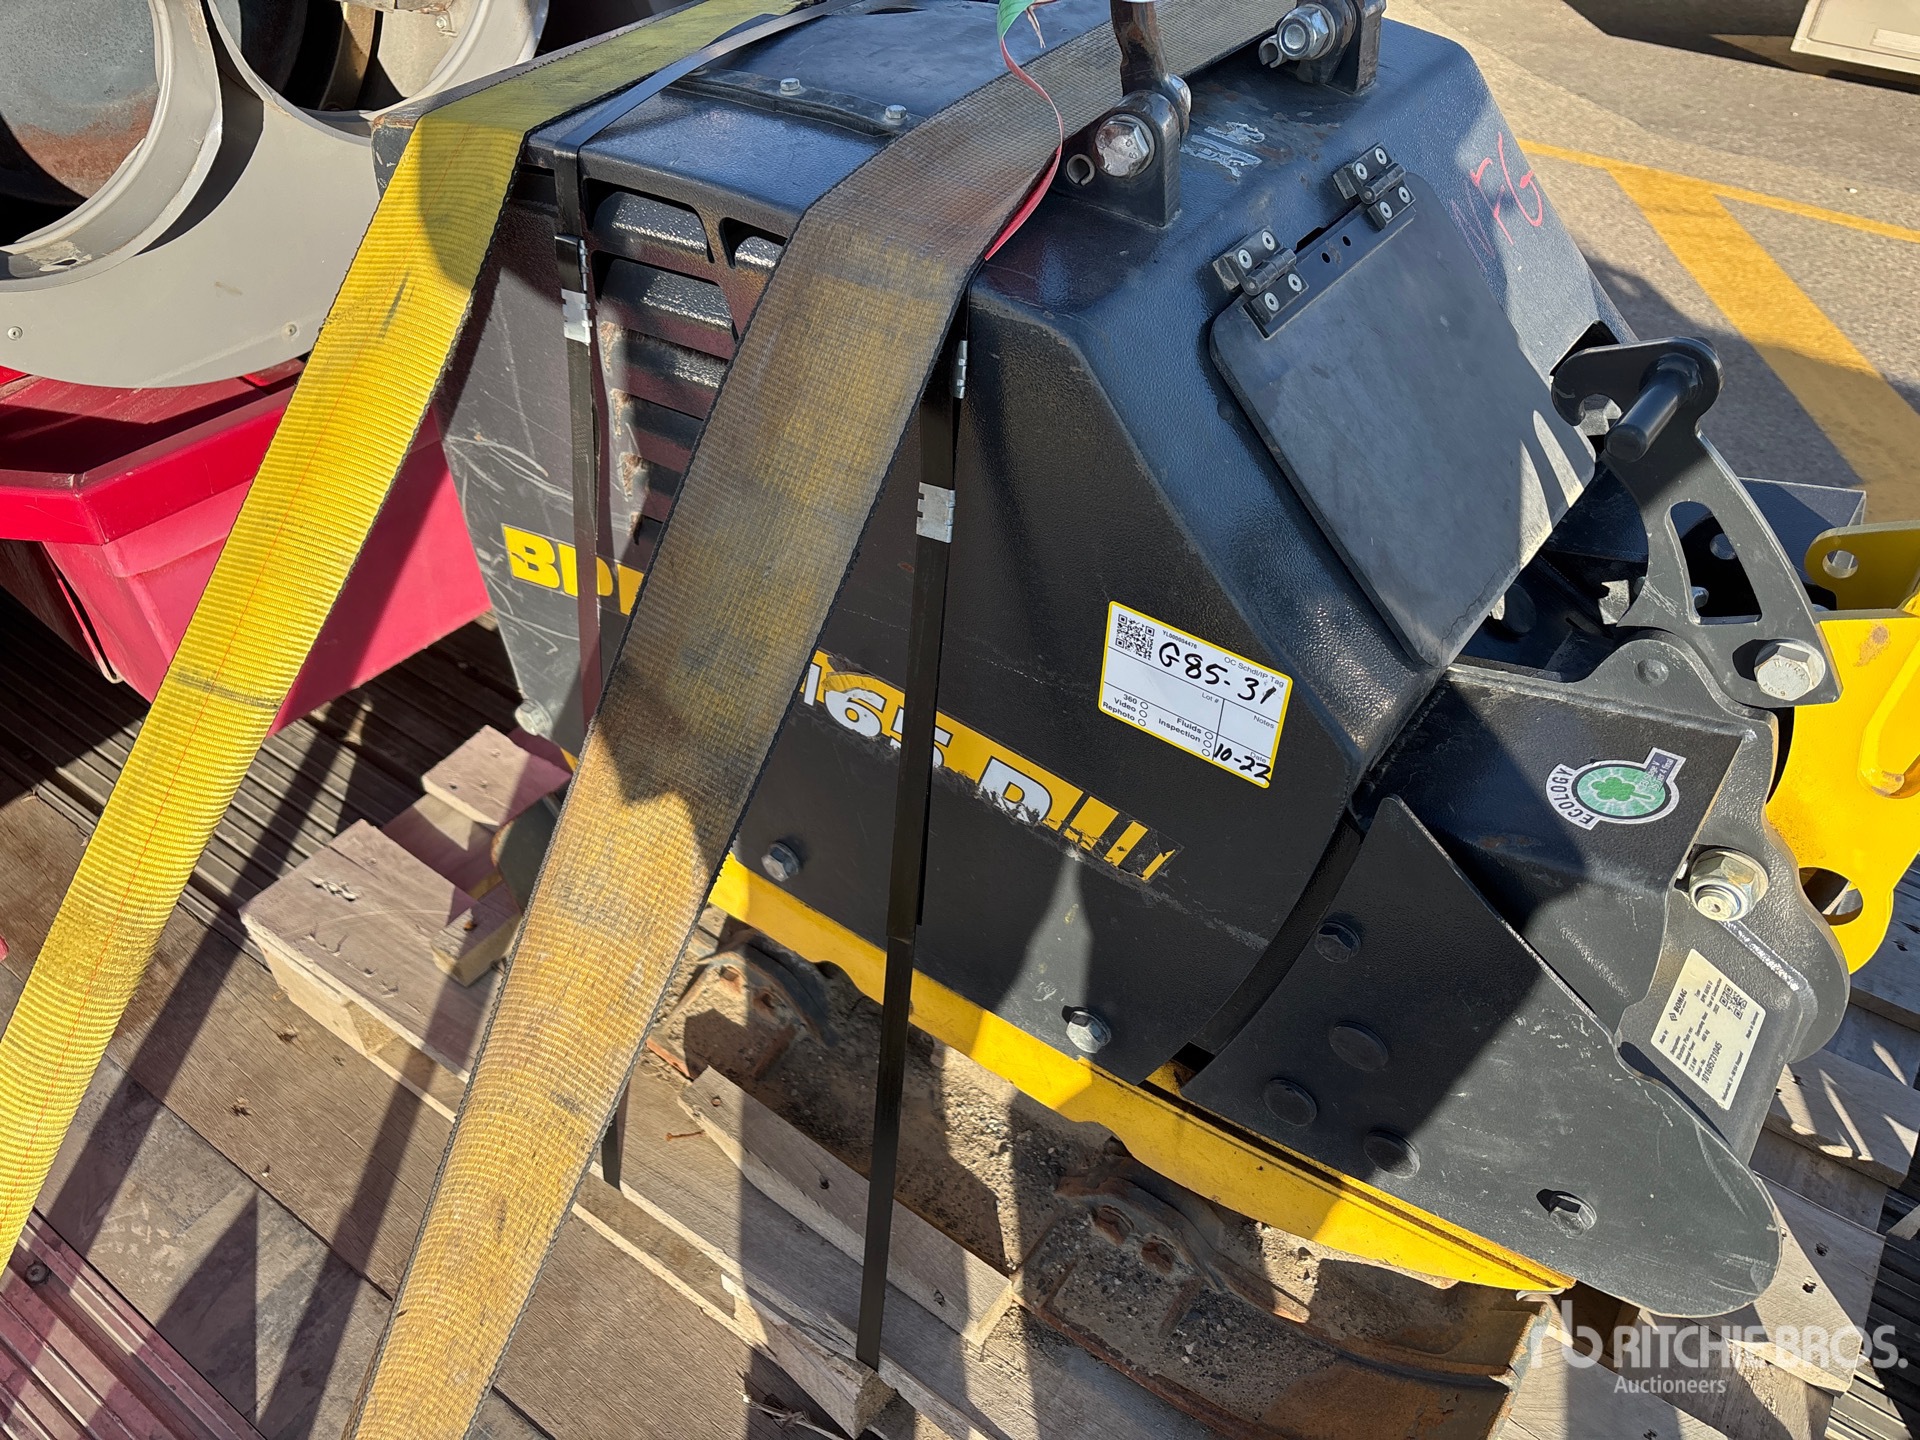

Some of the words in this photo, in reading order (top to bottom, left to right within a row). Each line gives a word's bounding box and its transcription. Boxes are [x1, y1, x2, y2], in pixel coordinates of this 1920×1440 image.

[1224, 656, 1237, 667] OC
[1270, 676, 1284, 688] Tag
[1114, 697, 1137, 712] Video
[1123, 693, 1137, 705] 360
[1201, 692, 1213, 703] Lot
[1103, 701, 1135, 721] Rephoto
[1158, 718, 1201, 743] Inspection
[1176, 717, 1202, 734] Fluids
[1253, 715, 1275, 729] Notes
[1249, 751, 1267, 763] Date
[1550, 767, 1596, 825] ECOLOGY
[1673, 987, 1687, 1013] BOMAG
